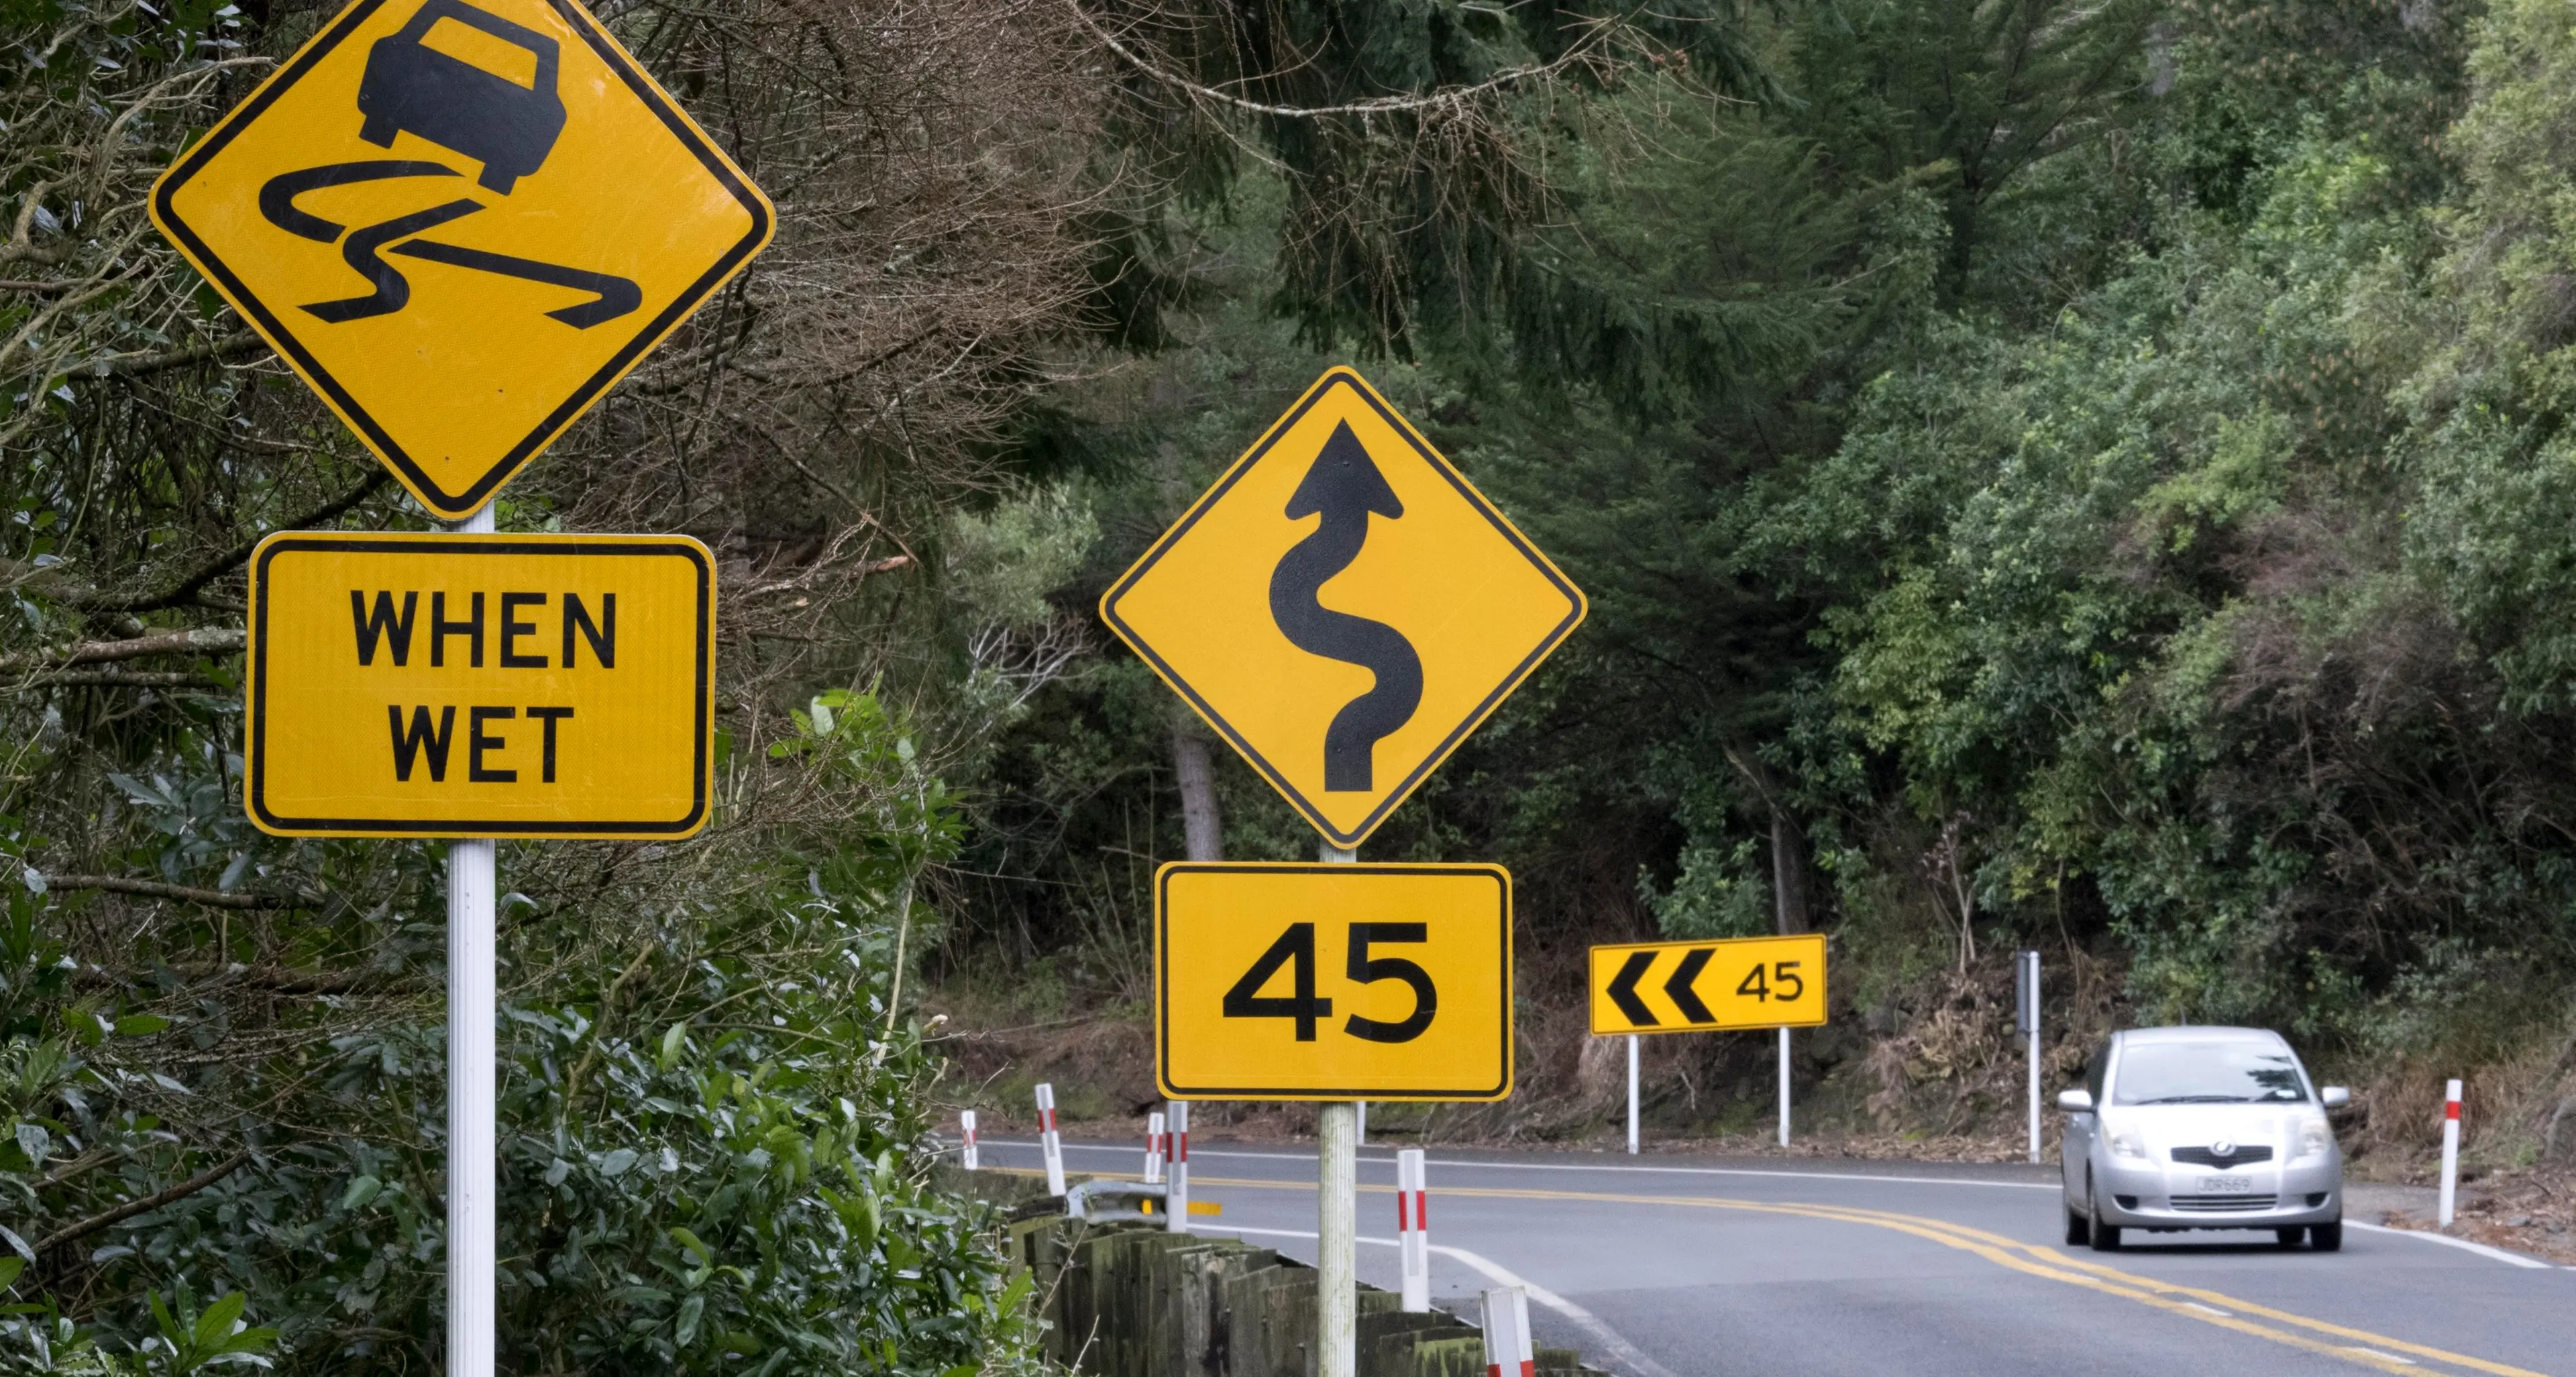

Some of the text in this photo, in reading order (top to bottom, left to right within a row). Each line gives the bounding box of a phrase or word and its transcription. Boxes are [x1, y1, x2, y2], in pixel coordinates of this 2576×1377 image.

[350, 590, 616, 669] WHEN
[388, 705, 574, 783] WET
[1223, 922, 1438, 1044] 45
[1736, 960, 1804, 1002] 45
